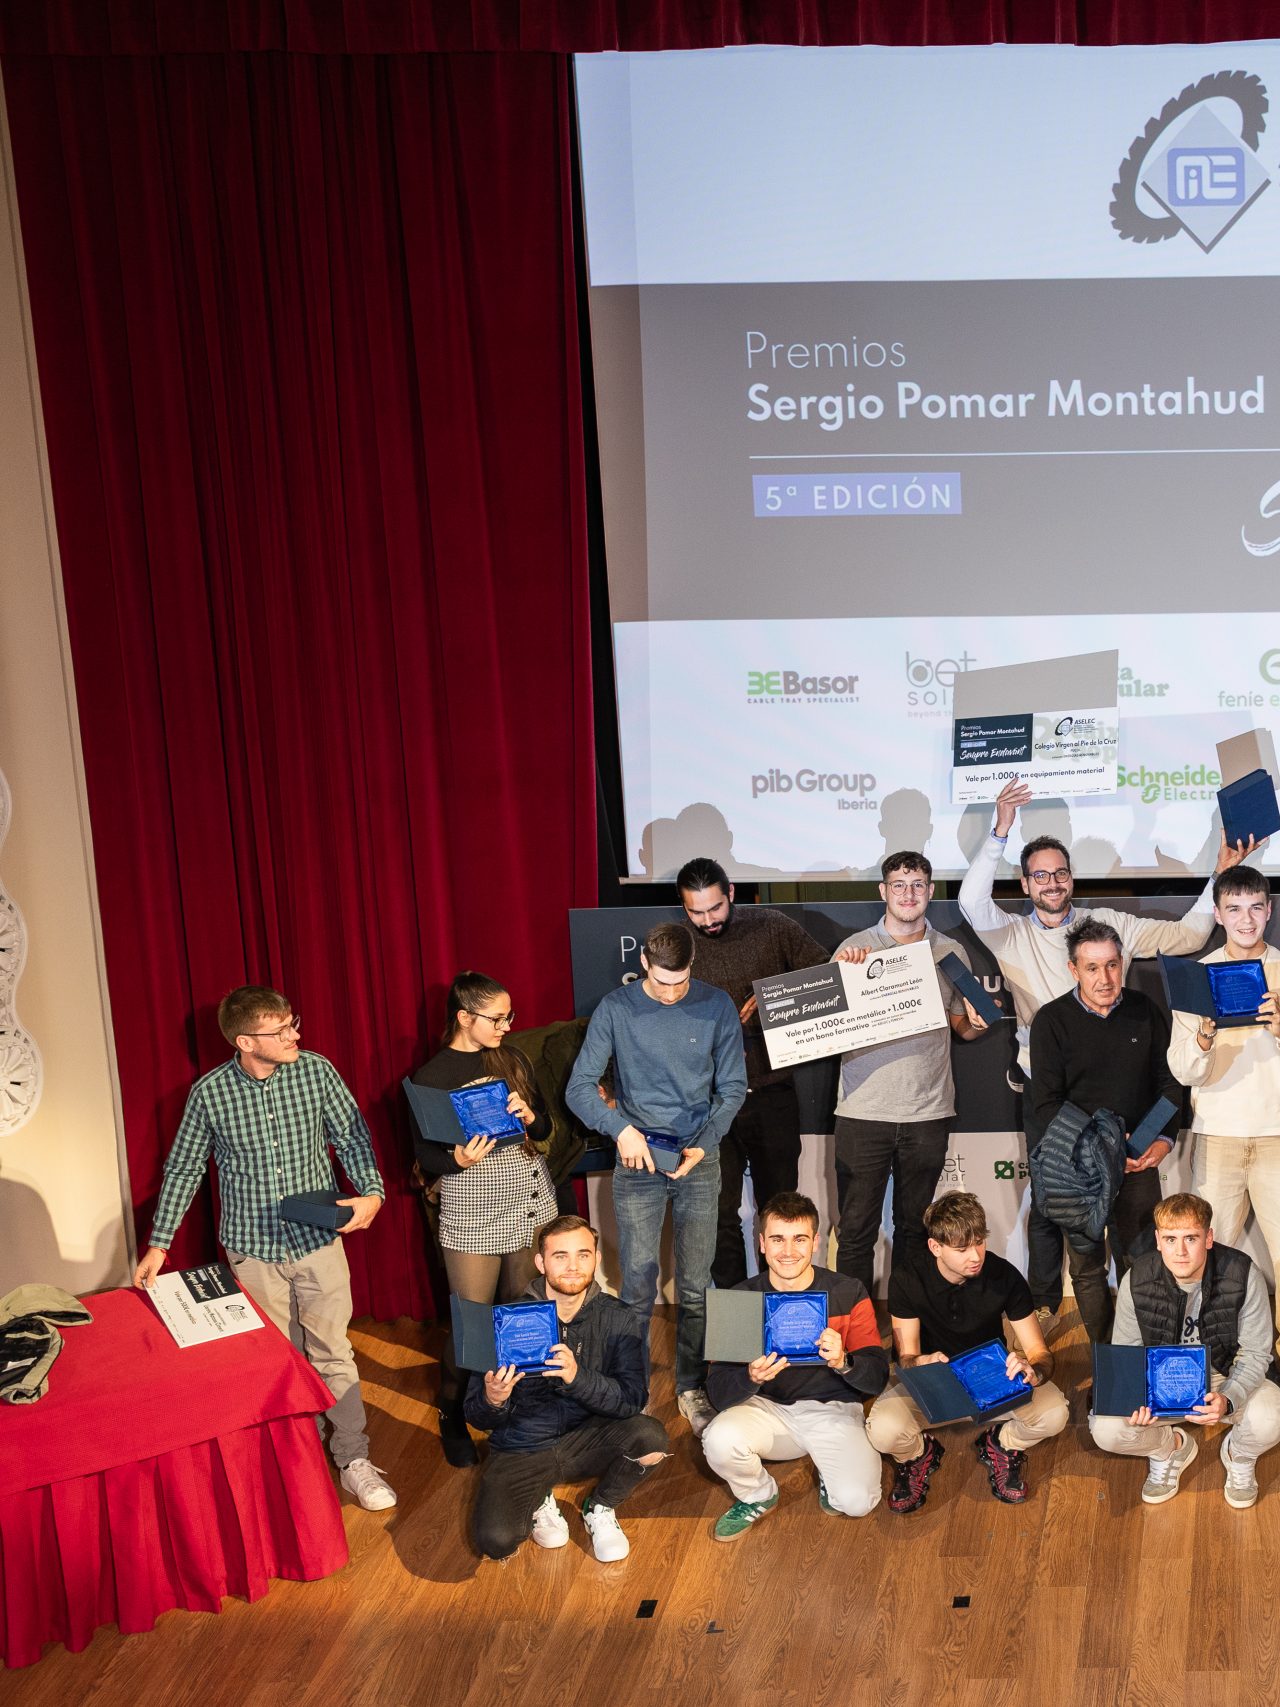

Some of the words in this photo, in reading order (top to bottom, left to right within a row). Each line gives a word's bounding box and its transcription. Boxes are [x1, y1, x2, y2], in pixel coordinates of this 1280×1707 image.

[746, 331, 906, 368] Premios
[747, 382, 884, 431] Sergio
[898, 381, 1035, 418] Pomar
[1048, 375, 1265, 416] Montahud
[765, 484, 798, 511] 5ª
[814, 477, 952, 510] EDICIÓN
[907, 688, 946, 706] sol
[1118, 679, 1169, 698] ular
[807, 696, 860, 704] SPECIALIST
[1074, 717, 1096, 725] ASELEC
[1034, 742, 1055, 751] Colegio
[1055, 740, 1074, 750] Virgen
[1080, 739, 1089, 747] Pie
[752, 768, 793, 799] pib
[795, 768, 877, 798] Group
[965, 774, 980, 783] Vale
[980, 775, 992, 783] por
[992, 771, 1020, 782] 1.000€
[1030, 769, 1076, 779] equipamiento
[1076, 766, 1105, 775] material
[1117, 764, 1221, 788] Schneide
[1164, 787, 1215, 801] Electr
[838, 798, 878, 810] Iberia
[885, 955, 908, 966] ASELEC
[861, 988, 879, 997] Albert
[879, 981, 909, 993] Claramunt
[785, 1027, 801, 1039] Vale
[803, 1027, 814, 1037] por
[814, 1017, 846, 1031] 1.000€
[856, 1009, 887, 1022] metálico
[892, 998, 923, 1013] 1.000€
[795, 1038, 805, 1046] en
[816, 1029, 835, 1041] bono
[835, 1021, 870, 1036] formativo
[943, 1154, 966, 1173] et
